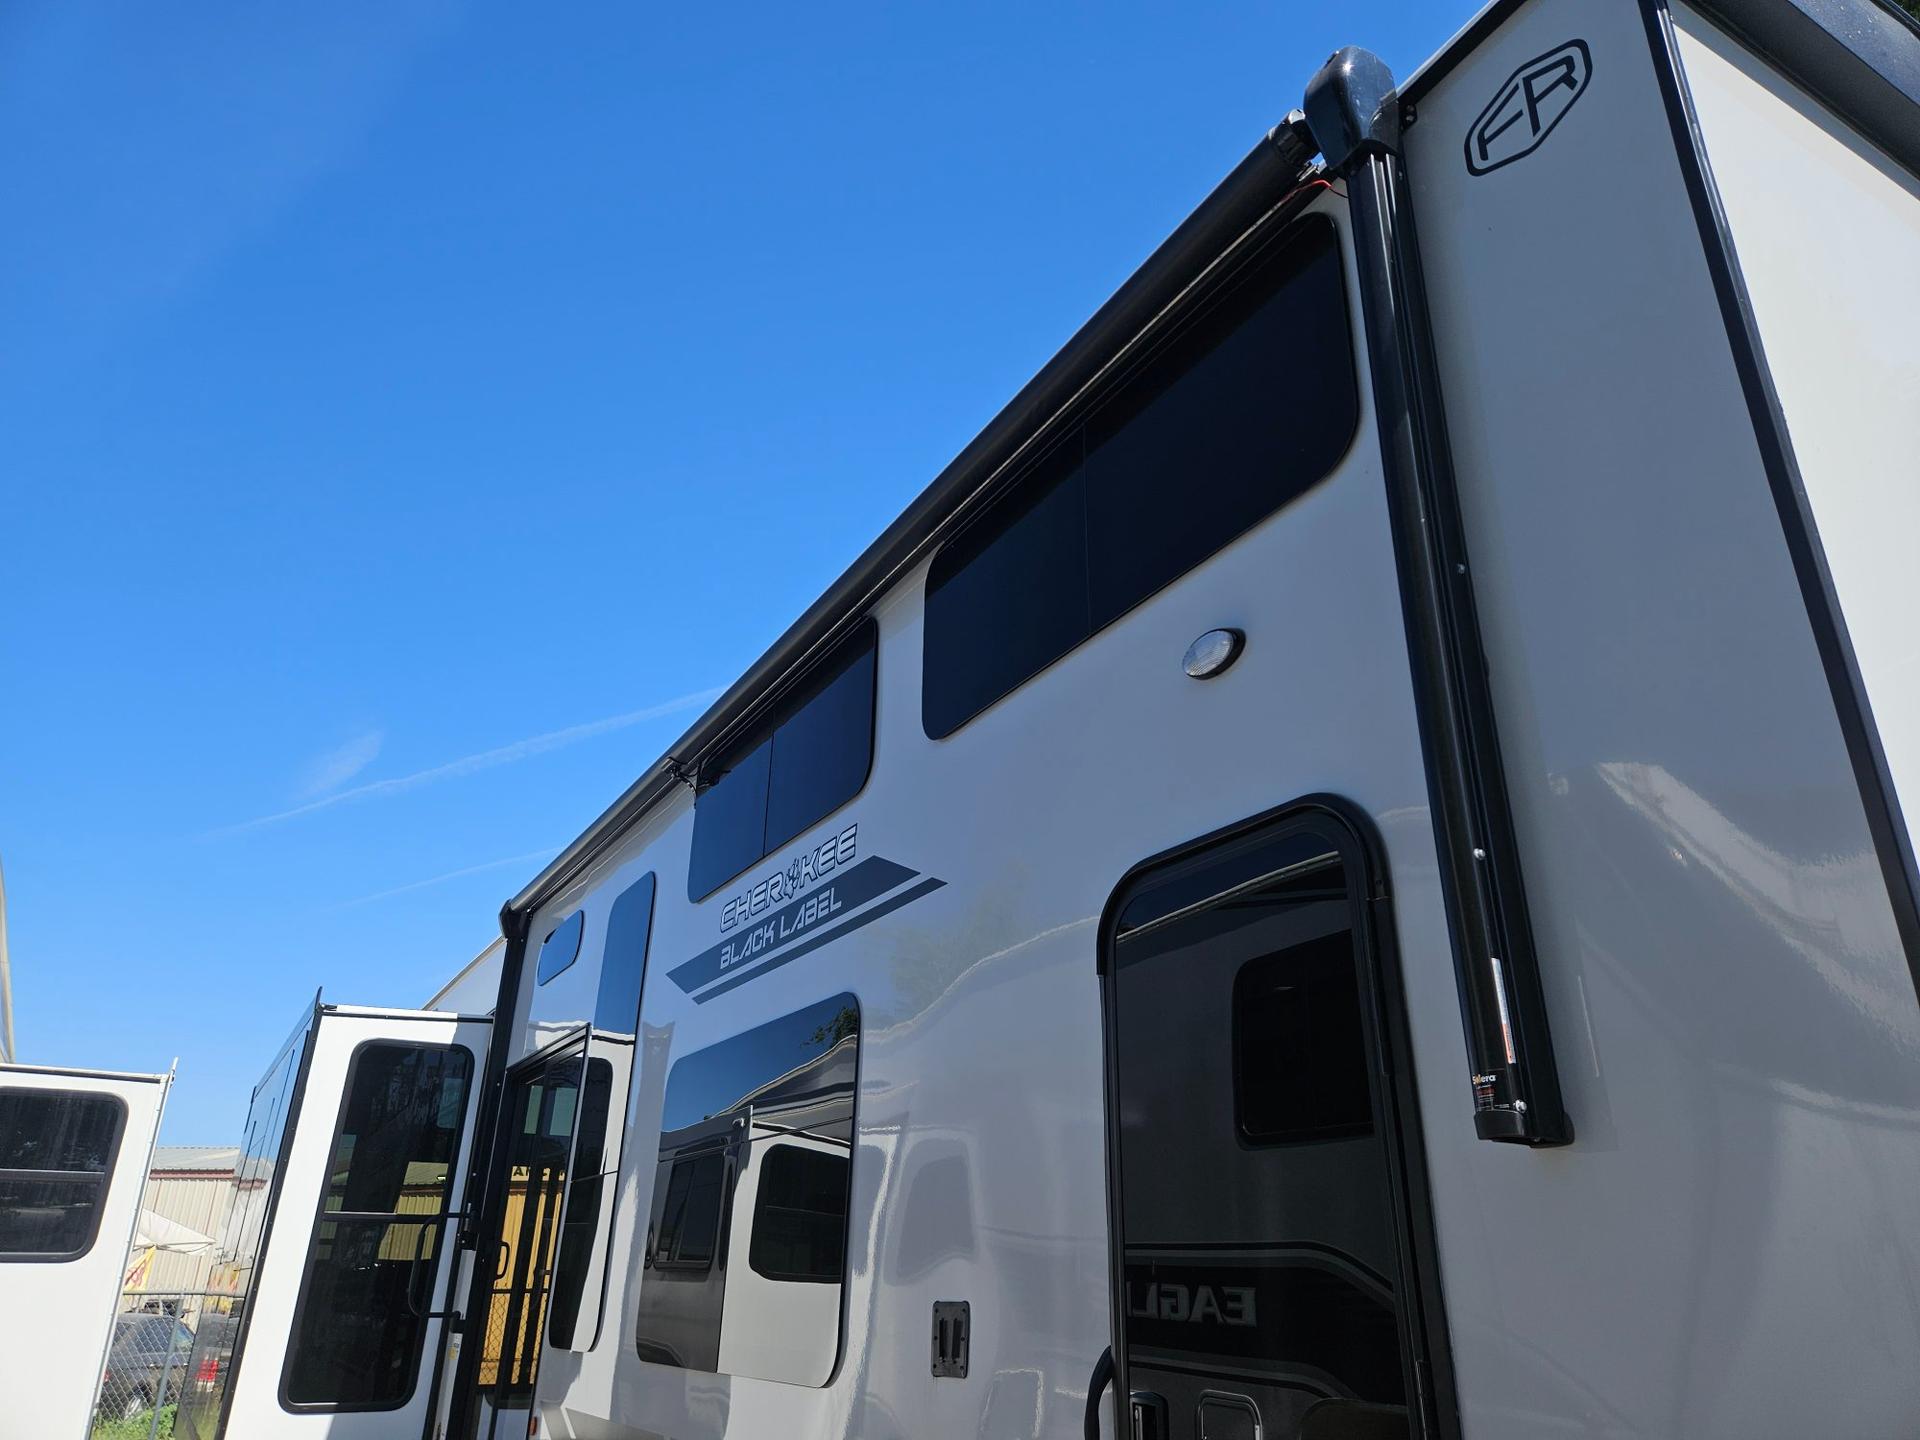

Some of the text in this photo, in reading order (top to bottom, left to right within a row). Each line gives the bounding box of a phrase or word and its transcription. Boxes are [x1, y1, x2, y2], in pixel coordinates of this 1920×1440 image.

[1477, 55, 1578, 161] FR
[719, 887, 842, 970] BLACK LABEL
